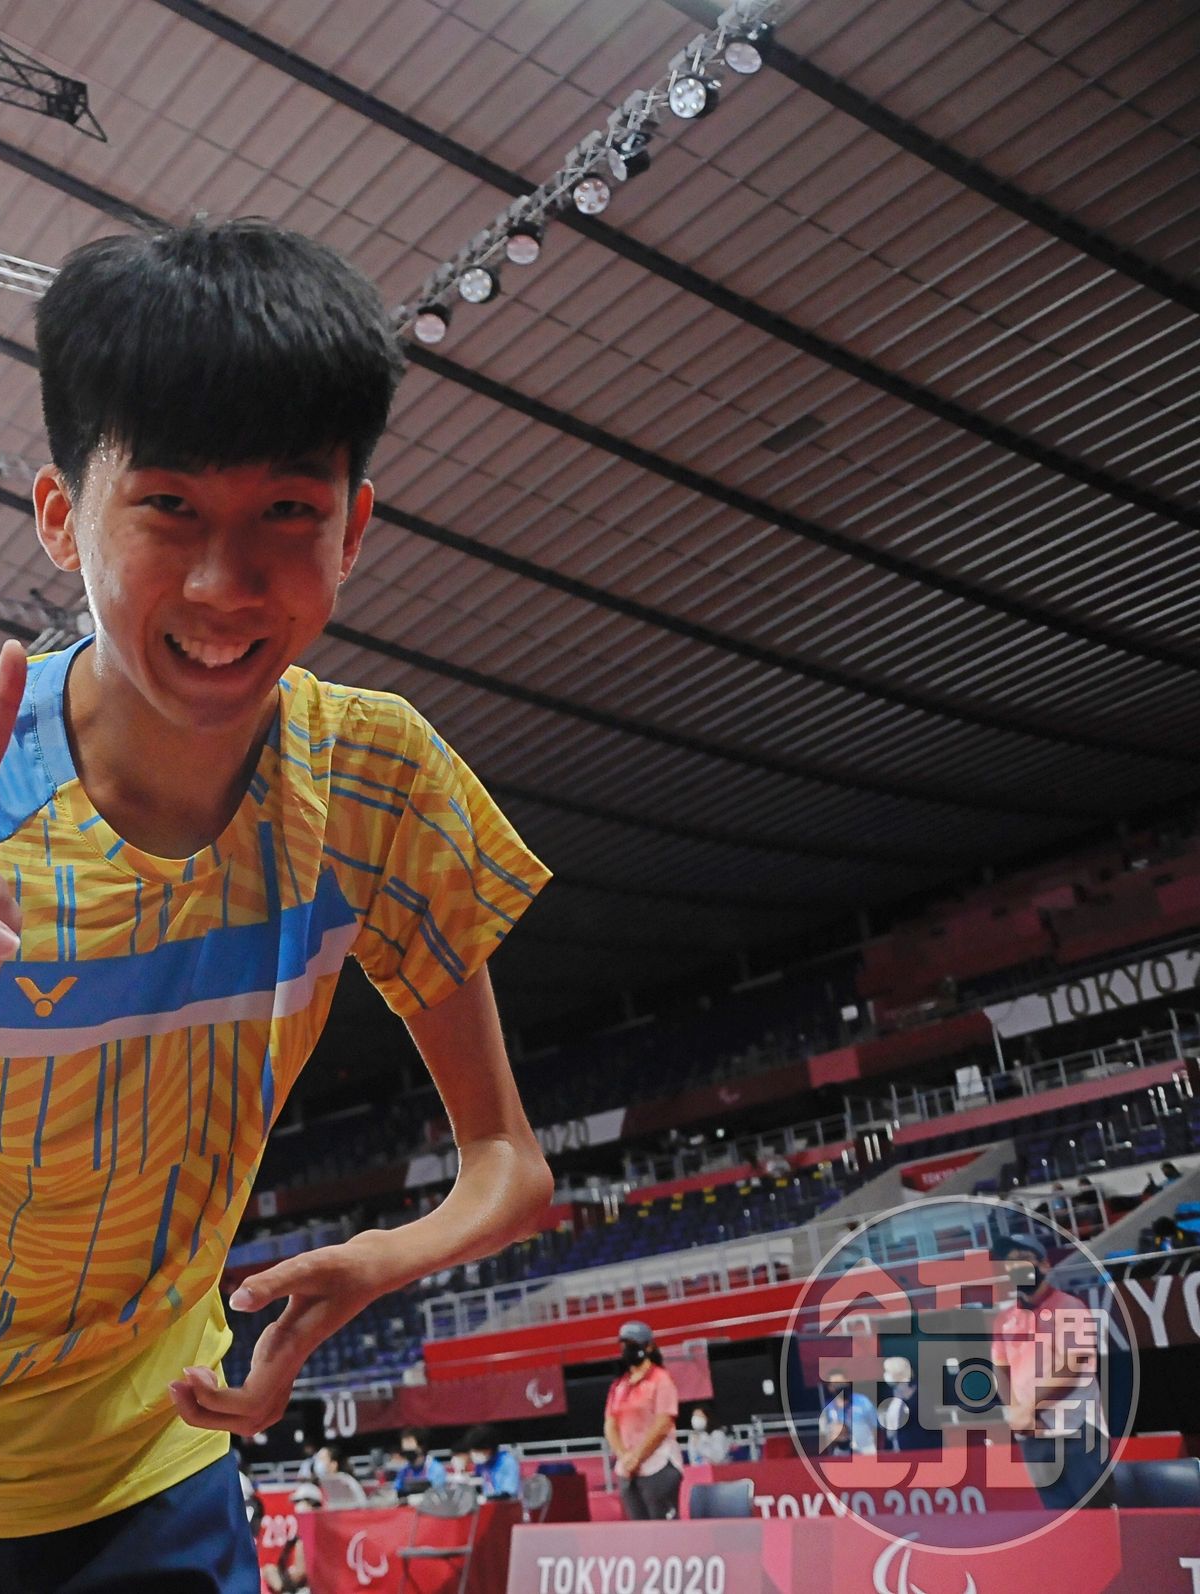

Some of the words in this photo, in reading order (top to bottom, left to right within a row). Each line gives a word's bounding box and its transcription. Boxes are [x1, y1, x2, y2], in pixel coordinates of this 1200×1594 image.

[1037, 955, 1177, 1025] TOKYO
[537, 1556, 636, 1594] TOKYO
[642, 1555, 726, 1594] 2020
